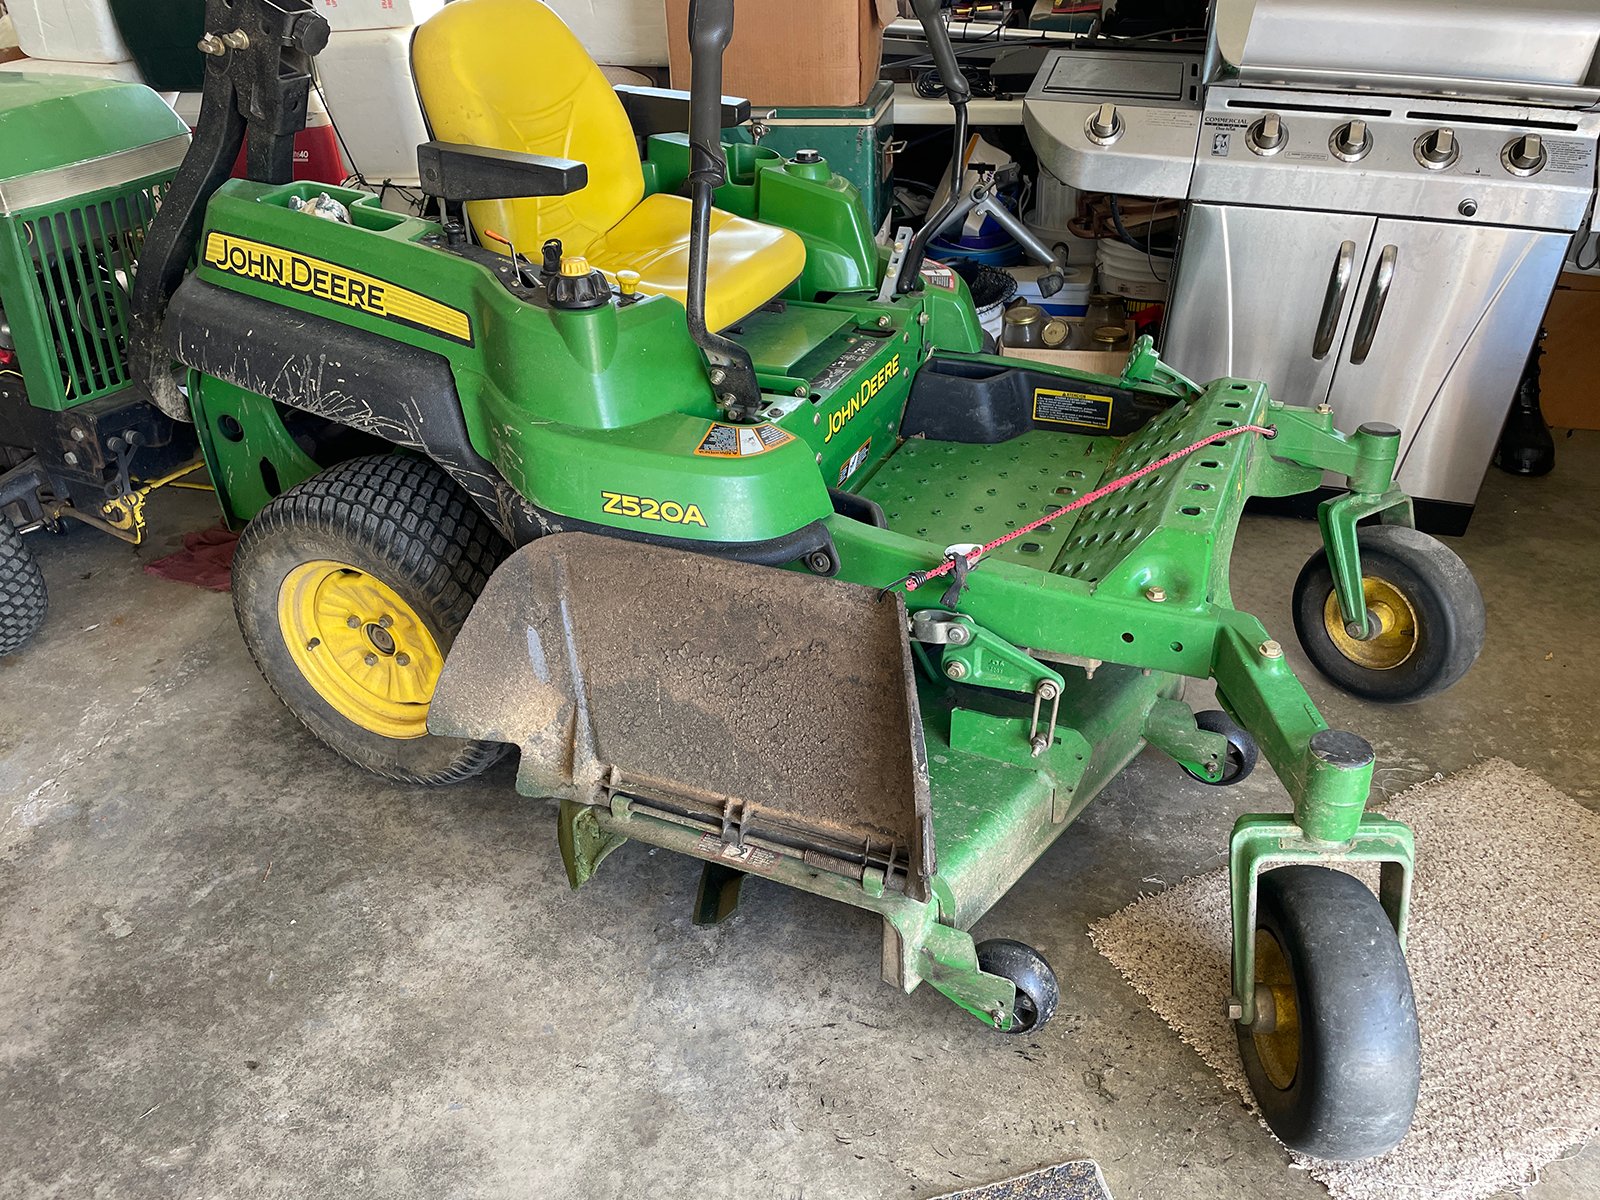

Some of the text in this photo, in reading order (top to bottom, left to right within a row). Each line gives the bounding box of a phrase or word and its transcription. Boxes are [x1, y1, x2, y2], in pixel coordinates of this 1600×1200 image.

[1204, 116, 1247, 124] COMMERCIAL
[217, 239, 386, 314] JOHN DEERE
[824, 352, 900, 443] JOHN DEERE
[600, 490, 708, 528] Z520A
